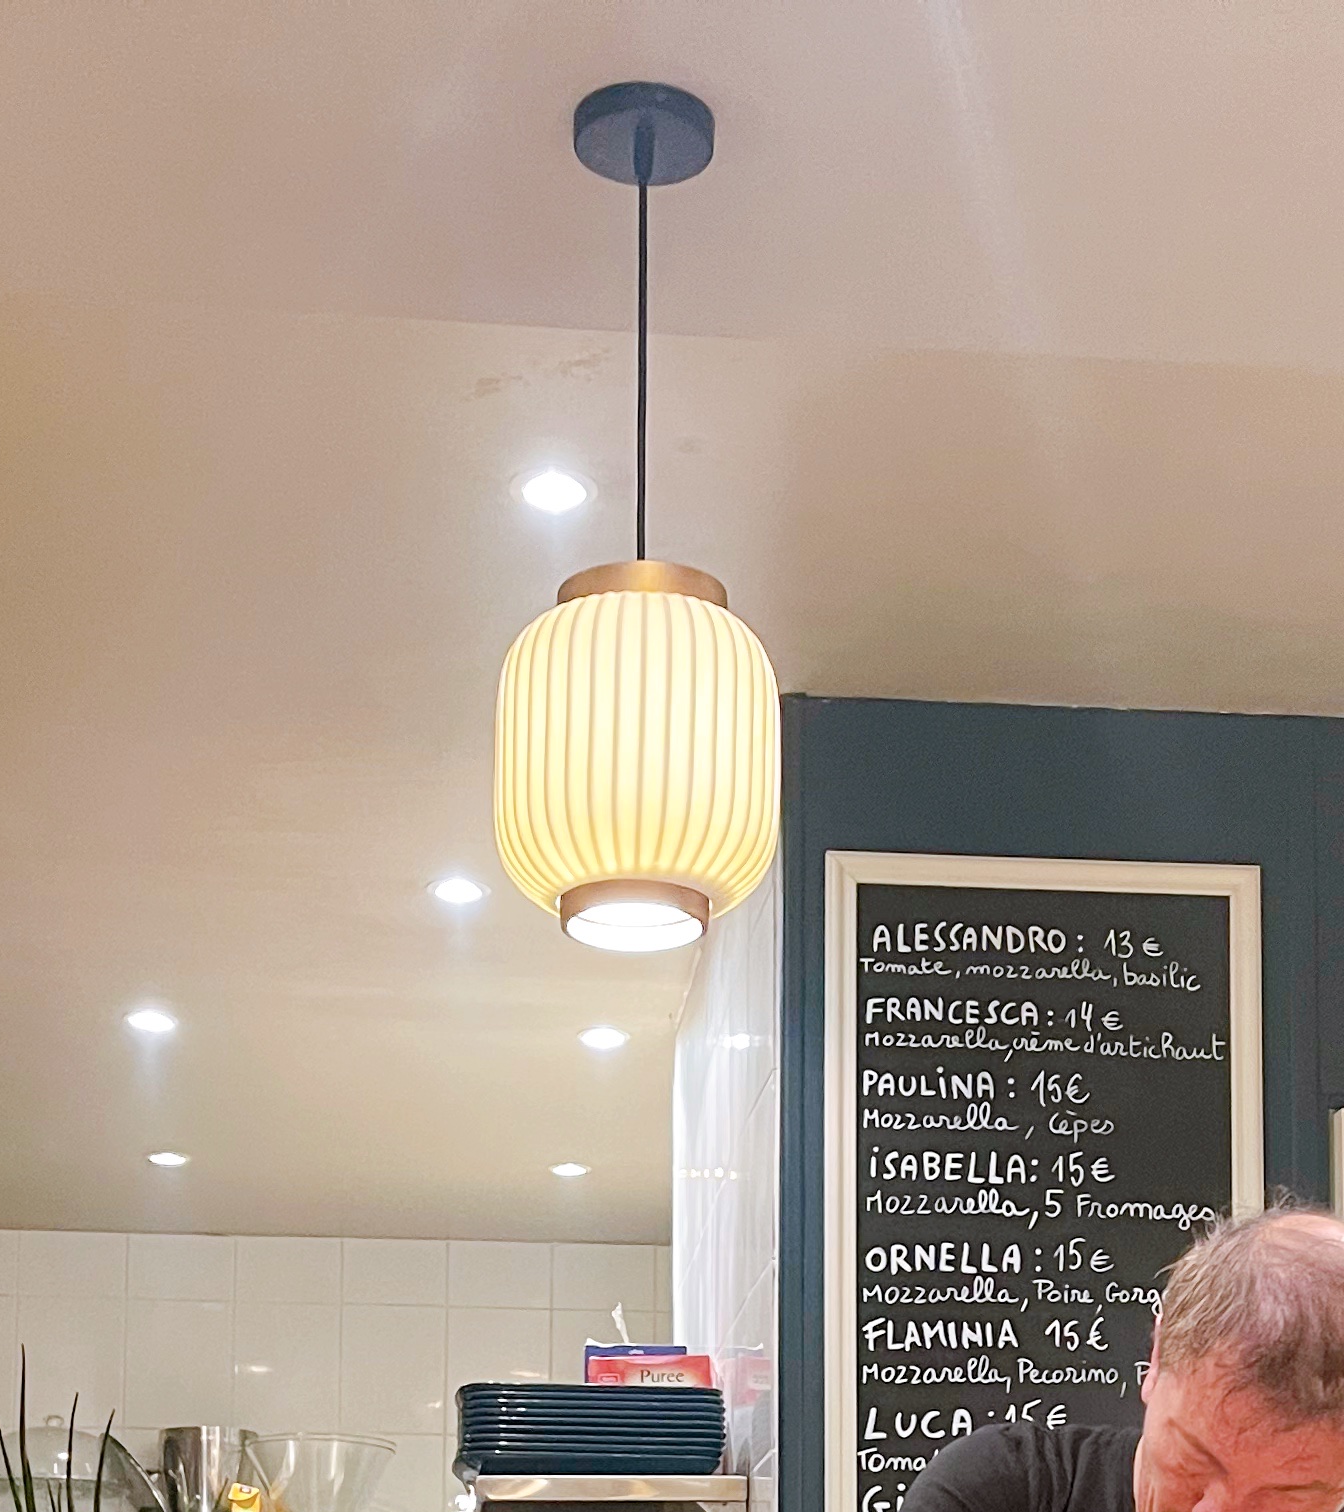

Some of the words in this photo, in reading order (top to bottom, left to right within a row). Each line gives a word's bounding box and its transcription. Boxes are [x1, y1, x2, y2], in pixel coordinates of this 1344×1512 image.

[1123, 961, 1202, 992] basilic
[1042, 1188, 1065, 1218] 5
[1076, 1189, 1216, 1231] Fromages
[861, 1317, 1019, 1351] FLAMINIA
[640, 1369, 685, 1384] Puree
